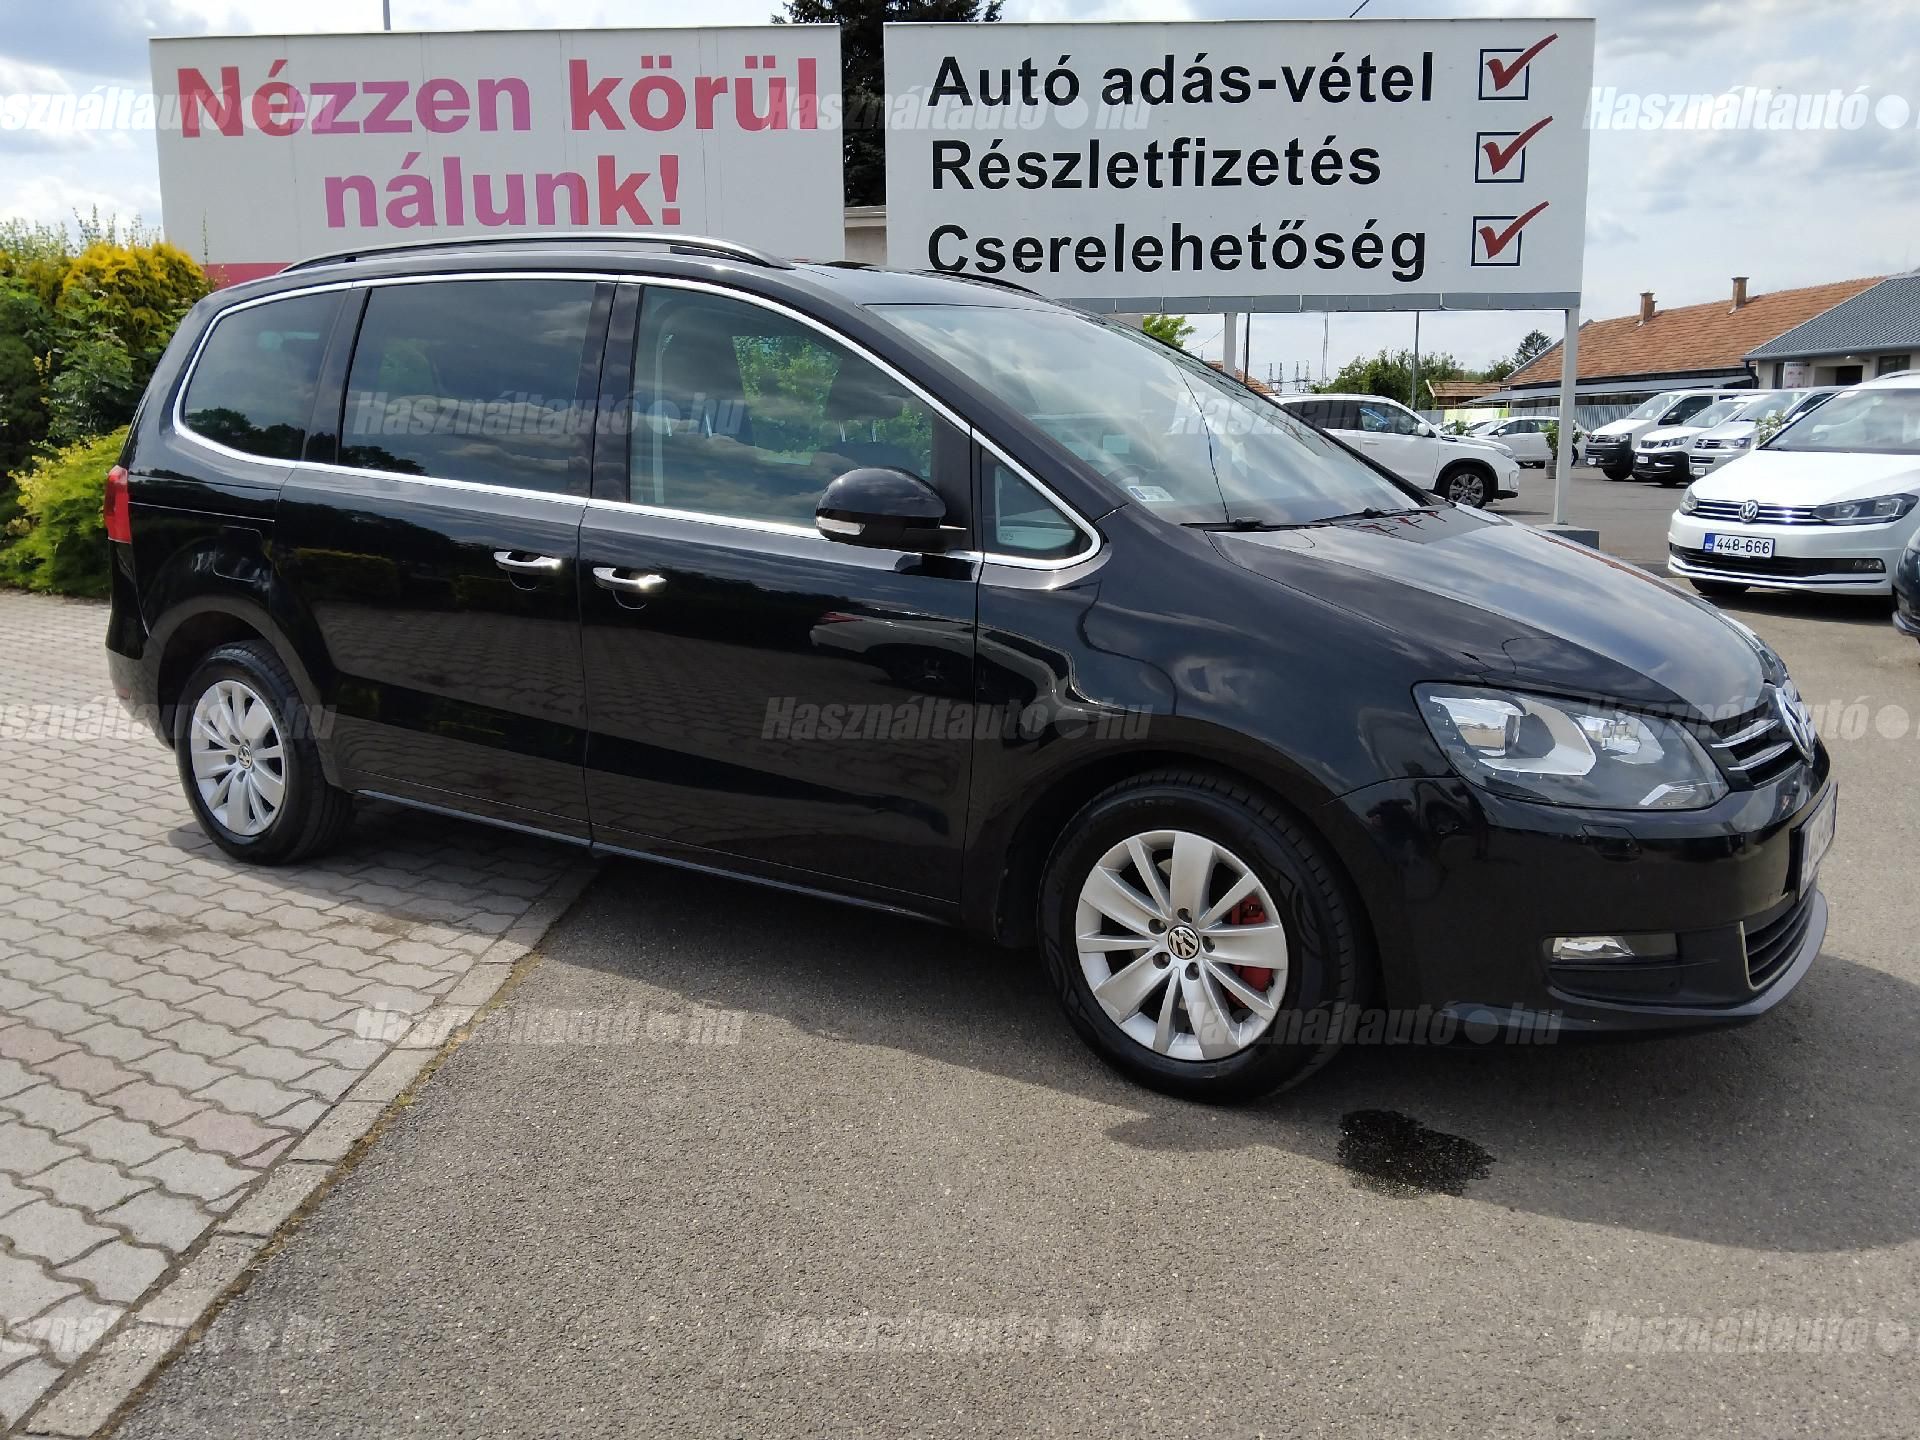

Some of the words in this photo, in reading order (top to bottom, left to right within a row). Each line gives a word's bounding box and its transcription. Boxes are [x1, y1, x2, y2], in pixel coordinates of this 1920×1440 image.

[177, 59, 532, 139] Nézzen
[570, 55, 819, 134] körül
[928, 54, 1081, 107] Autó
[1102, 52, 1434, 106] adás-vétel
[325, 151, 682, 230] nálunk!
[933, 134, 1382, 191] Részletfizetés
[926, 217, 1427, 282] Cserelehetőség
